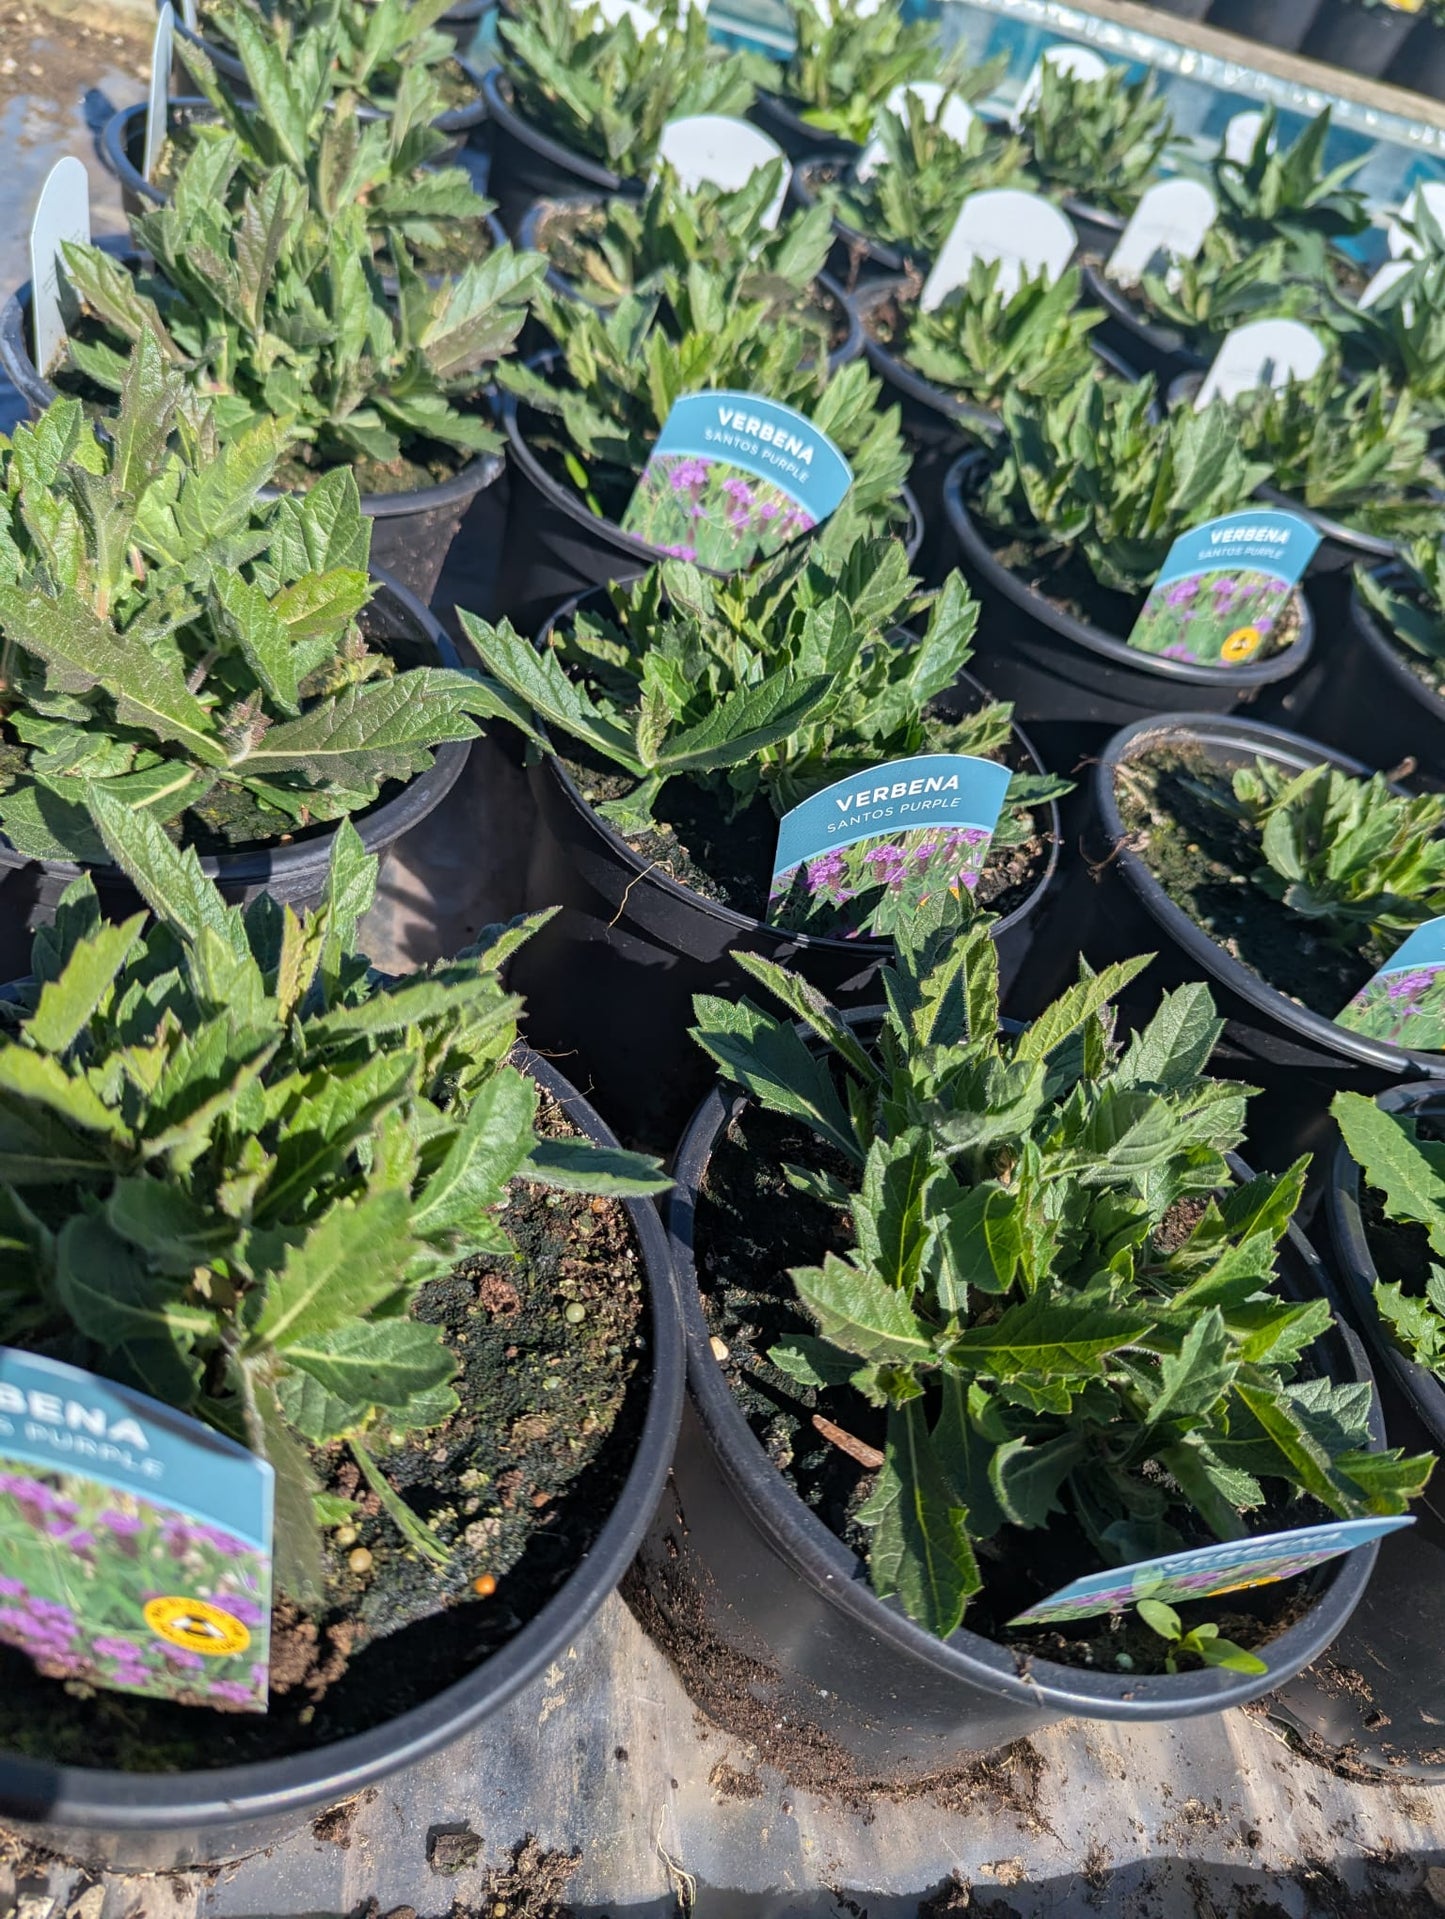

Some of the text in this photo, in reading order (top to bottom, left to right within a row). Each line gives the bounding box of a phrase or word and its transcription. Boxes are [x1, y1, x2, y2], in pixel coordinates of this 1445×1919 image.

[717, 406, 814, 465] VERBENA
[705, 428, 810, 484] SANTOS PURPLE
[1197, 546, 1285, 560] SANTOS PURPLE
[1210, 526, 1291, 545] VERBENA
[836, 774, 960, 812] VERBENA
[827, 797, 962, 833] SANTOS PURPLE
[24, 1421, 165, 1480] PURPLE
